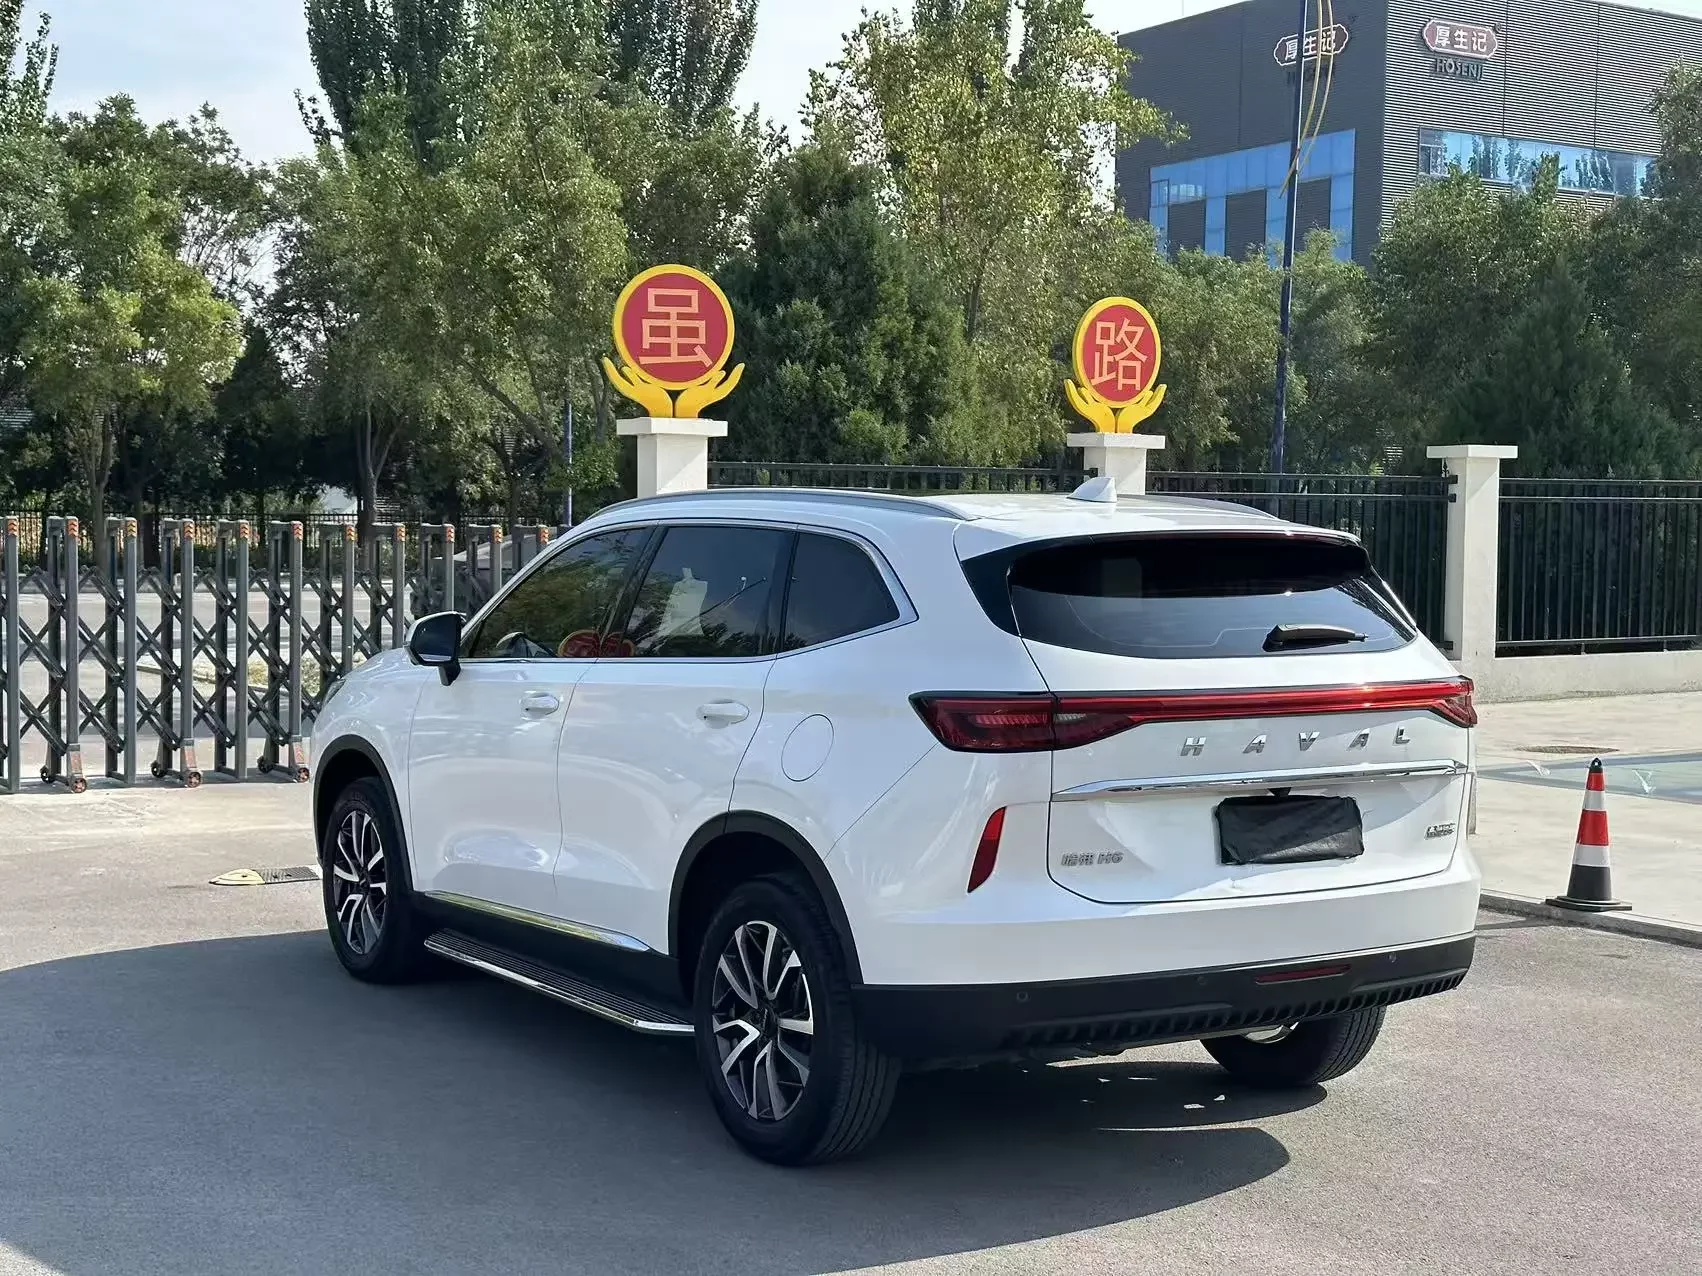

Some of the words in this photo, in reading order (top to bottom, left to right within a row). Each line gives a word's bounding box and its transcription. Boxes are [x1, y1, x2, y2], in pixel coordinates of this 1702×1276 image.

[1435, 25, 1487, 52] 厚生记
[639, 287, 713, 368] 虽
[1090, 317, 1148, 391] 路
[1180, 726, 1411, 757] HAVAL
